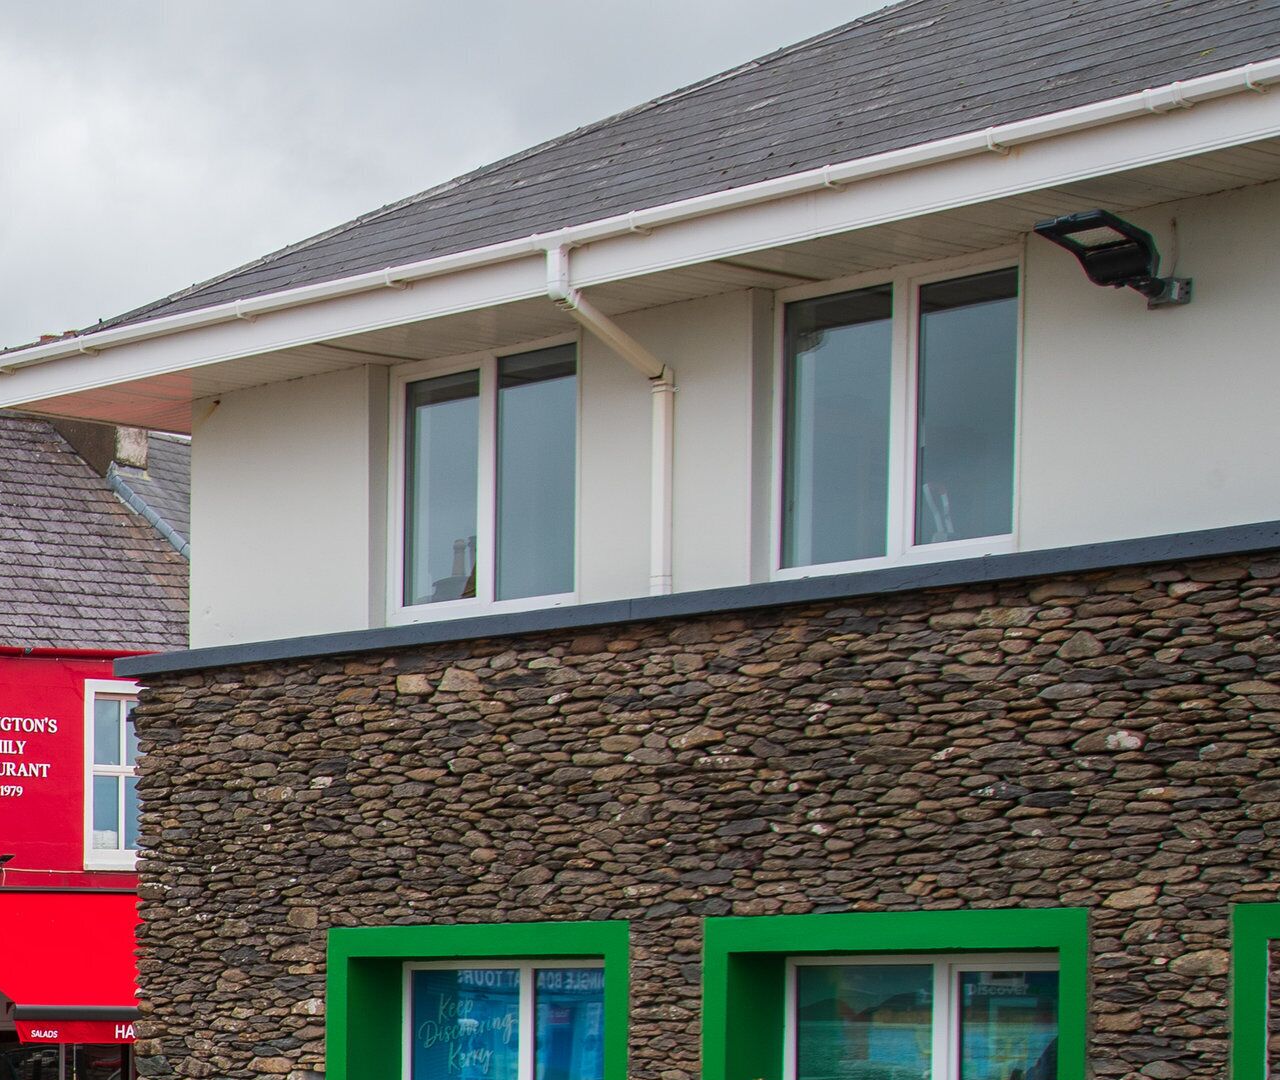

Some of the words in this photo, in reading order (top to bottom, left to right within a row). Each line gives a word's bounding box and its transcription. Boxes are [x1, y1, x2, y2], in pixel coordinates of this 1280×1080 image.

[0, 785, 23, 797] 1979
[438, 993, 474, 1024] Keep
[31, 1029, 58, 1038] SALADS
[418, 1012, 519, 1049] Discovering
[448, 1041, 493, 1074] Kerry
